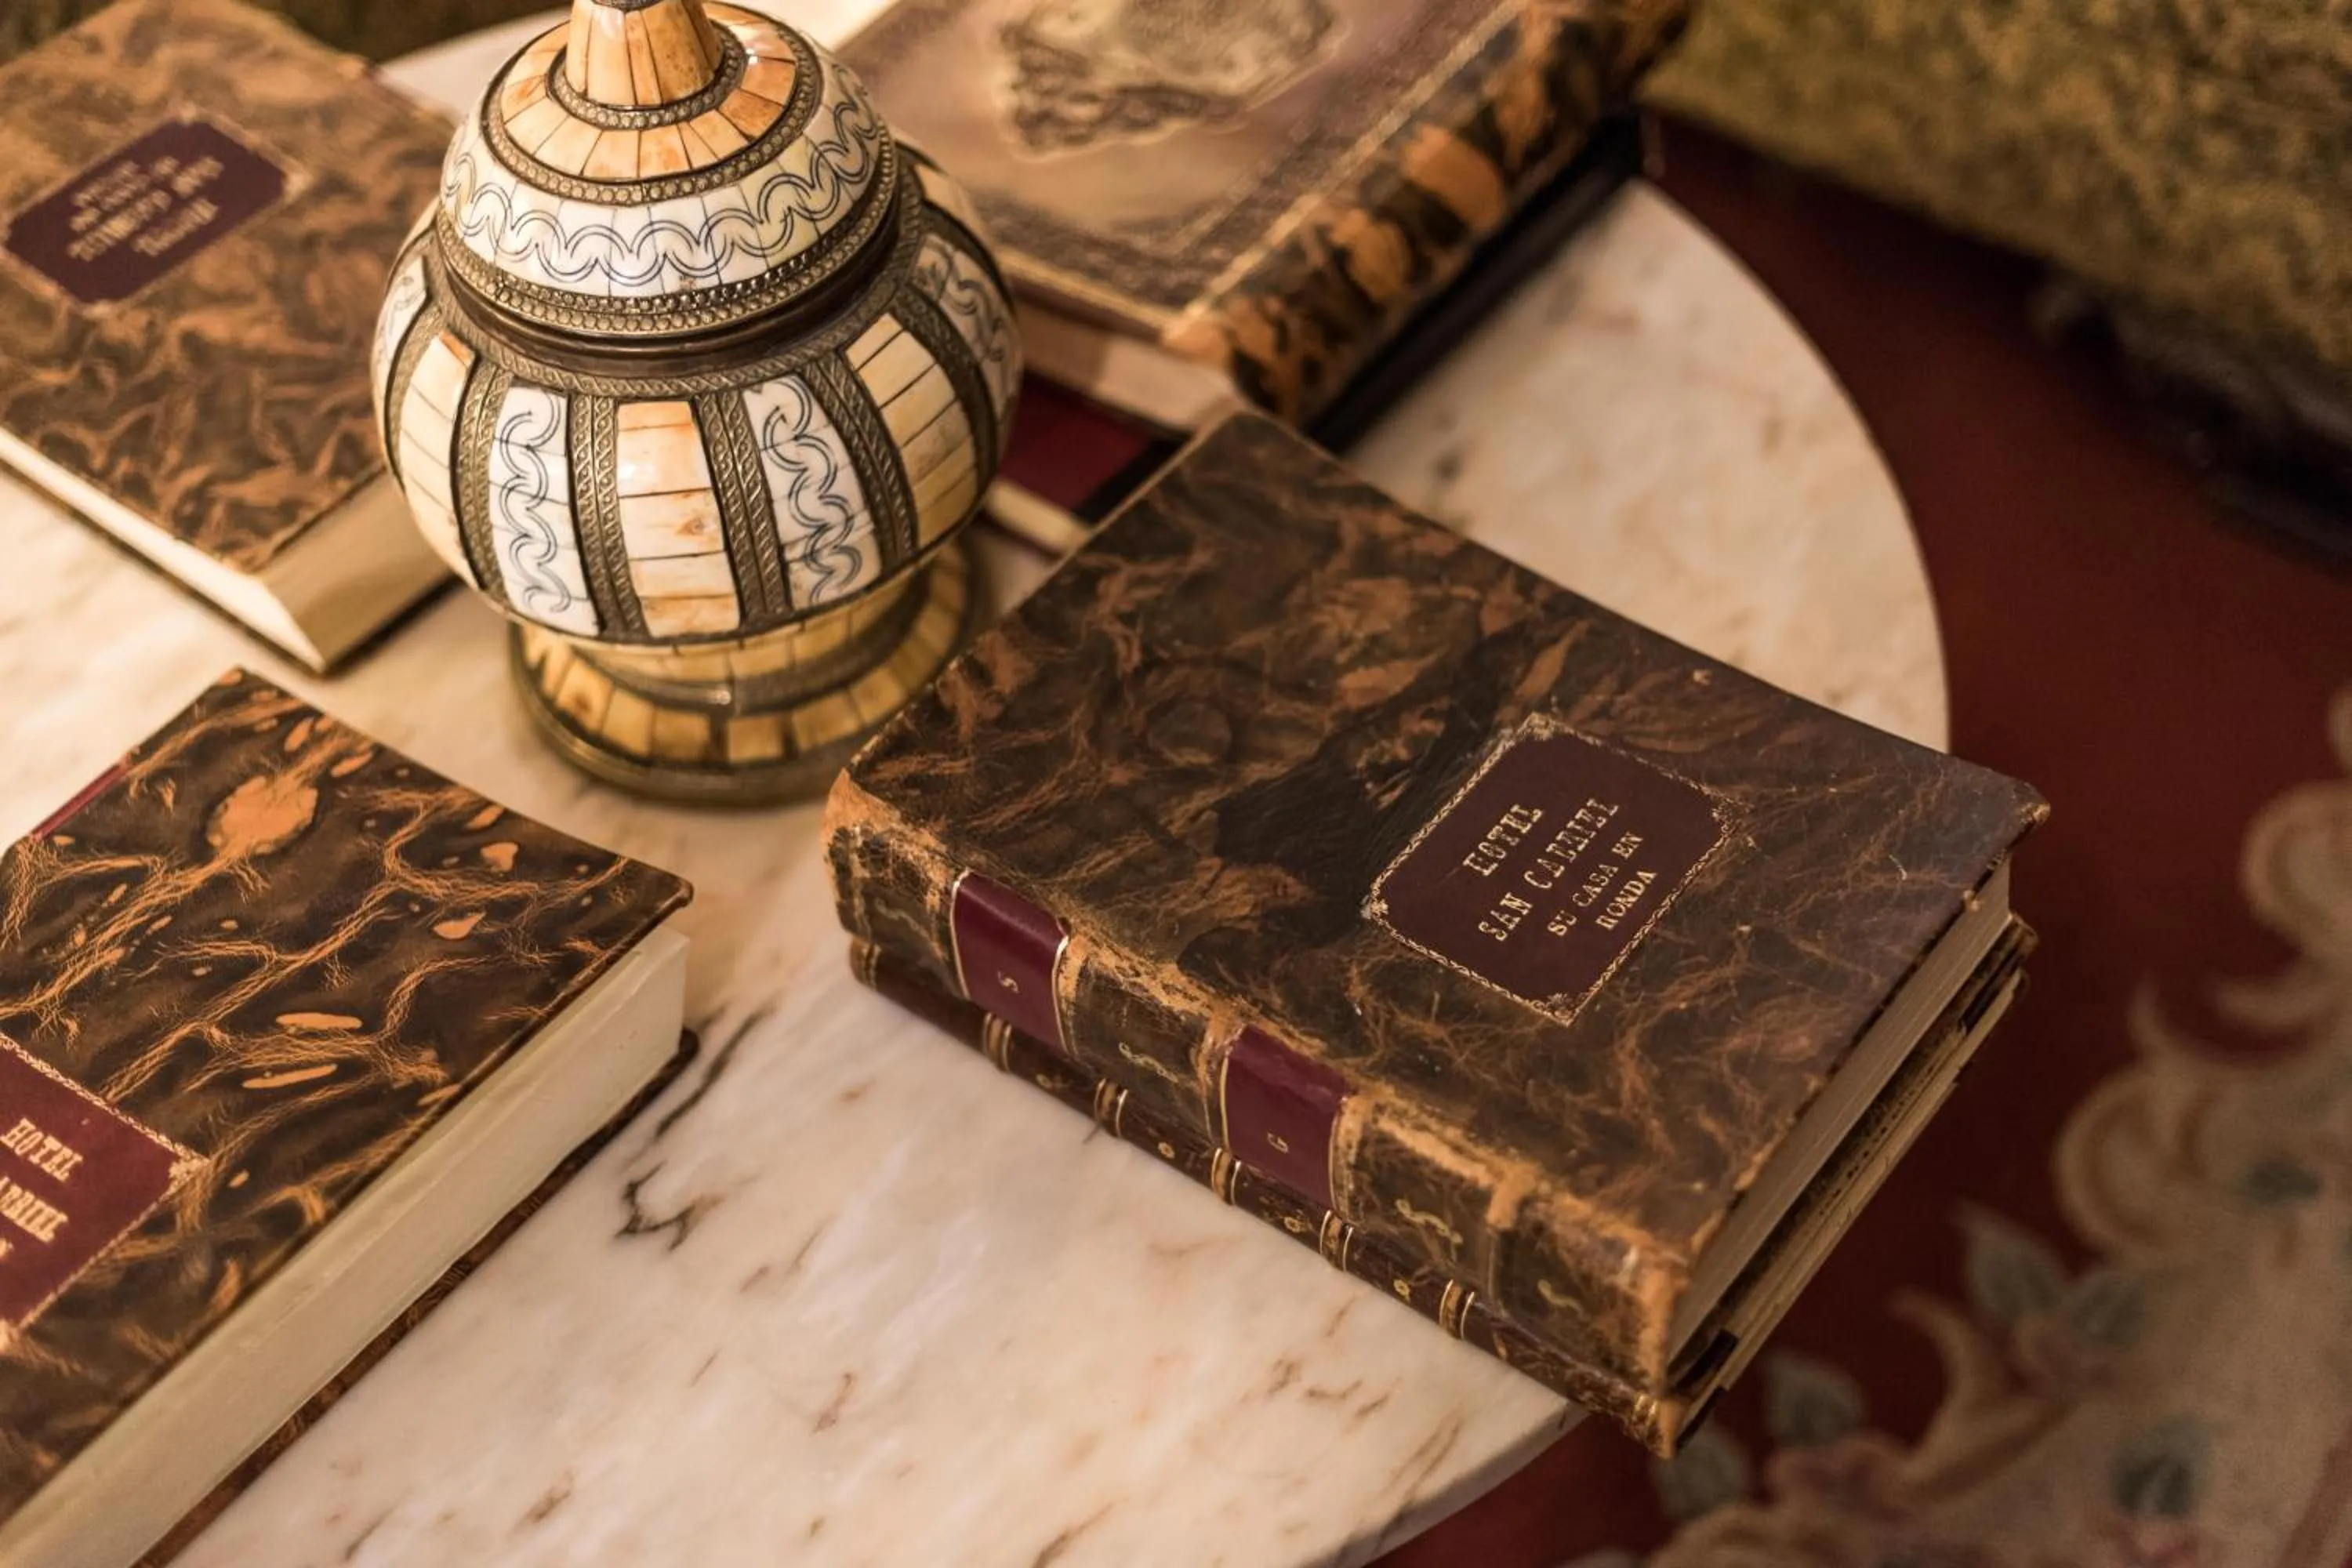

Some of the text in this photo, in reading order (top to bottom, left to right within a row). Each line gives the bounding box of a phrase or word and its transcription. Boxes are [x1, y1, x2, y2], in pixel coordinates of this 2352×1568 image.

[1462, 804, 1543, 876] HOTEL
[1573, 864, 1618, 908] CASA
[1612, 832, 1643, 859] EN
[1479, 892, 1533, 941] SAN
[1595, 870, 1657, 930] RONDA
[0, 1119, 83, 1182] HOTEL
